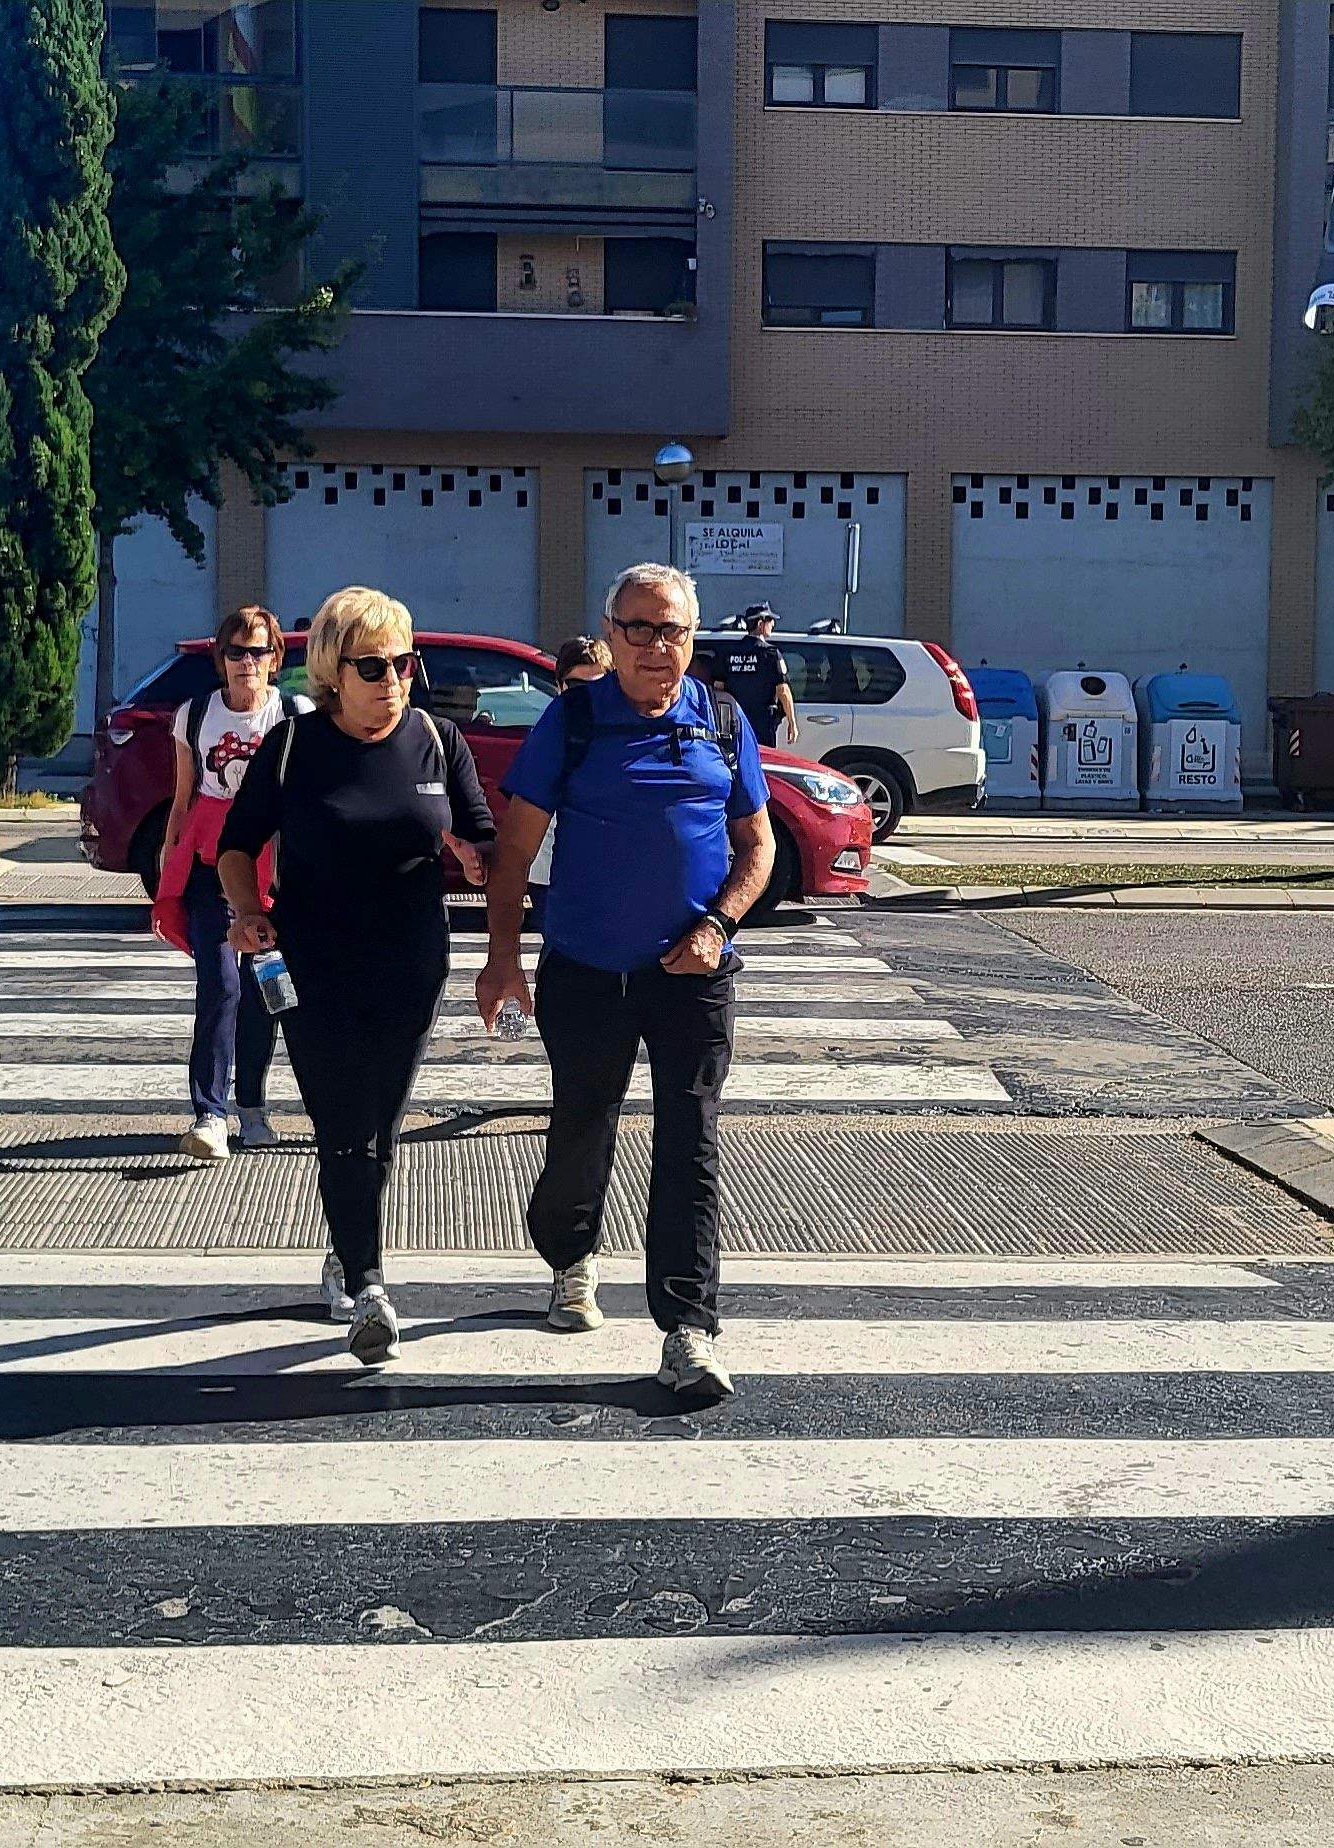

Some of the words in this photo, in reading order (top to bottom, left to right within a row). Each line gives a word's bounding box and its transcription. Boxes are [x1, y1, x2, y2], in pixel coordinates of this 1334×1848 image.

[703, 527, 714, 537] SE
[718, 528, 764, 538] ALQUILA
[1178, 774, 1217, 785] RESTO
